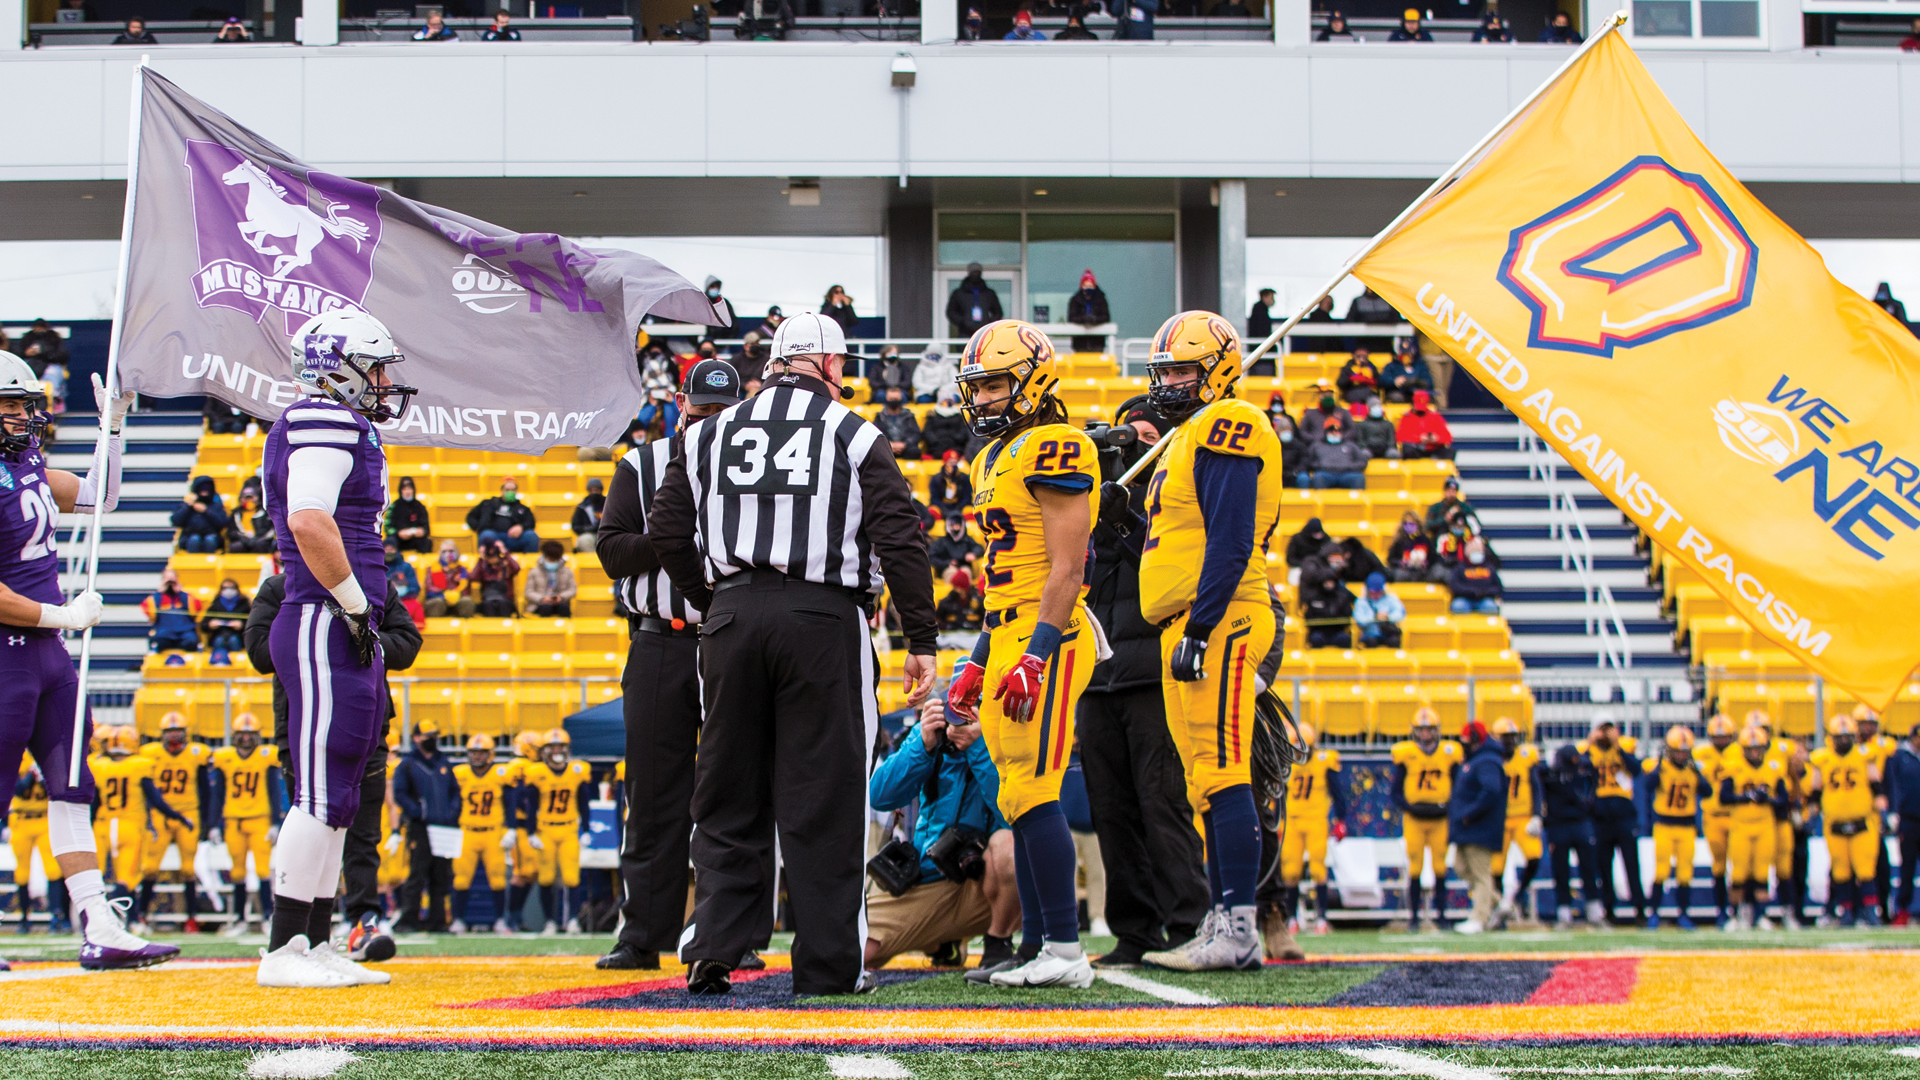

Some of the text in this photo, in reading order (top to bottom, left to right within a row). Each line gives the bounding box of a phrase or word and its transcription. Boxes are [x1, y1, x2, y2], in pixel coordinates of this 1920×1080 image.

[182, 352, 303, 409] UNITE
[374, 402, 507, 438] GAINST
[1766, 373, 1850, 445] WE
[1206, 417, 1253, 452] 62
[1716, 398, 1791, 465] OUA
[725, 426, 814, 487] 34
[1034, 440, 1082, 472] 22
[1414, 281, 1833, 658] UNITED AGAINST RACISM
[106, 777, 128, 811] 21
[232, 771, 259, 798] 54
[548, 789, 571, 815] 19
[468, 790, 494, 816] 58
